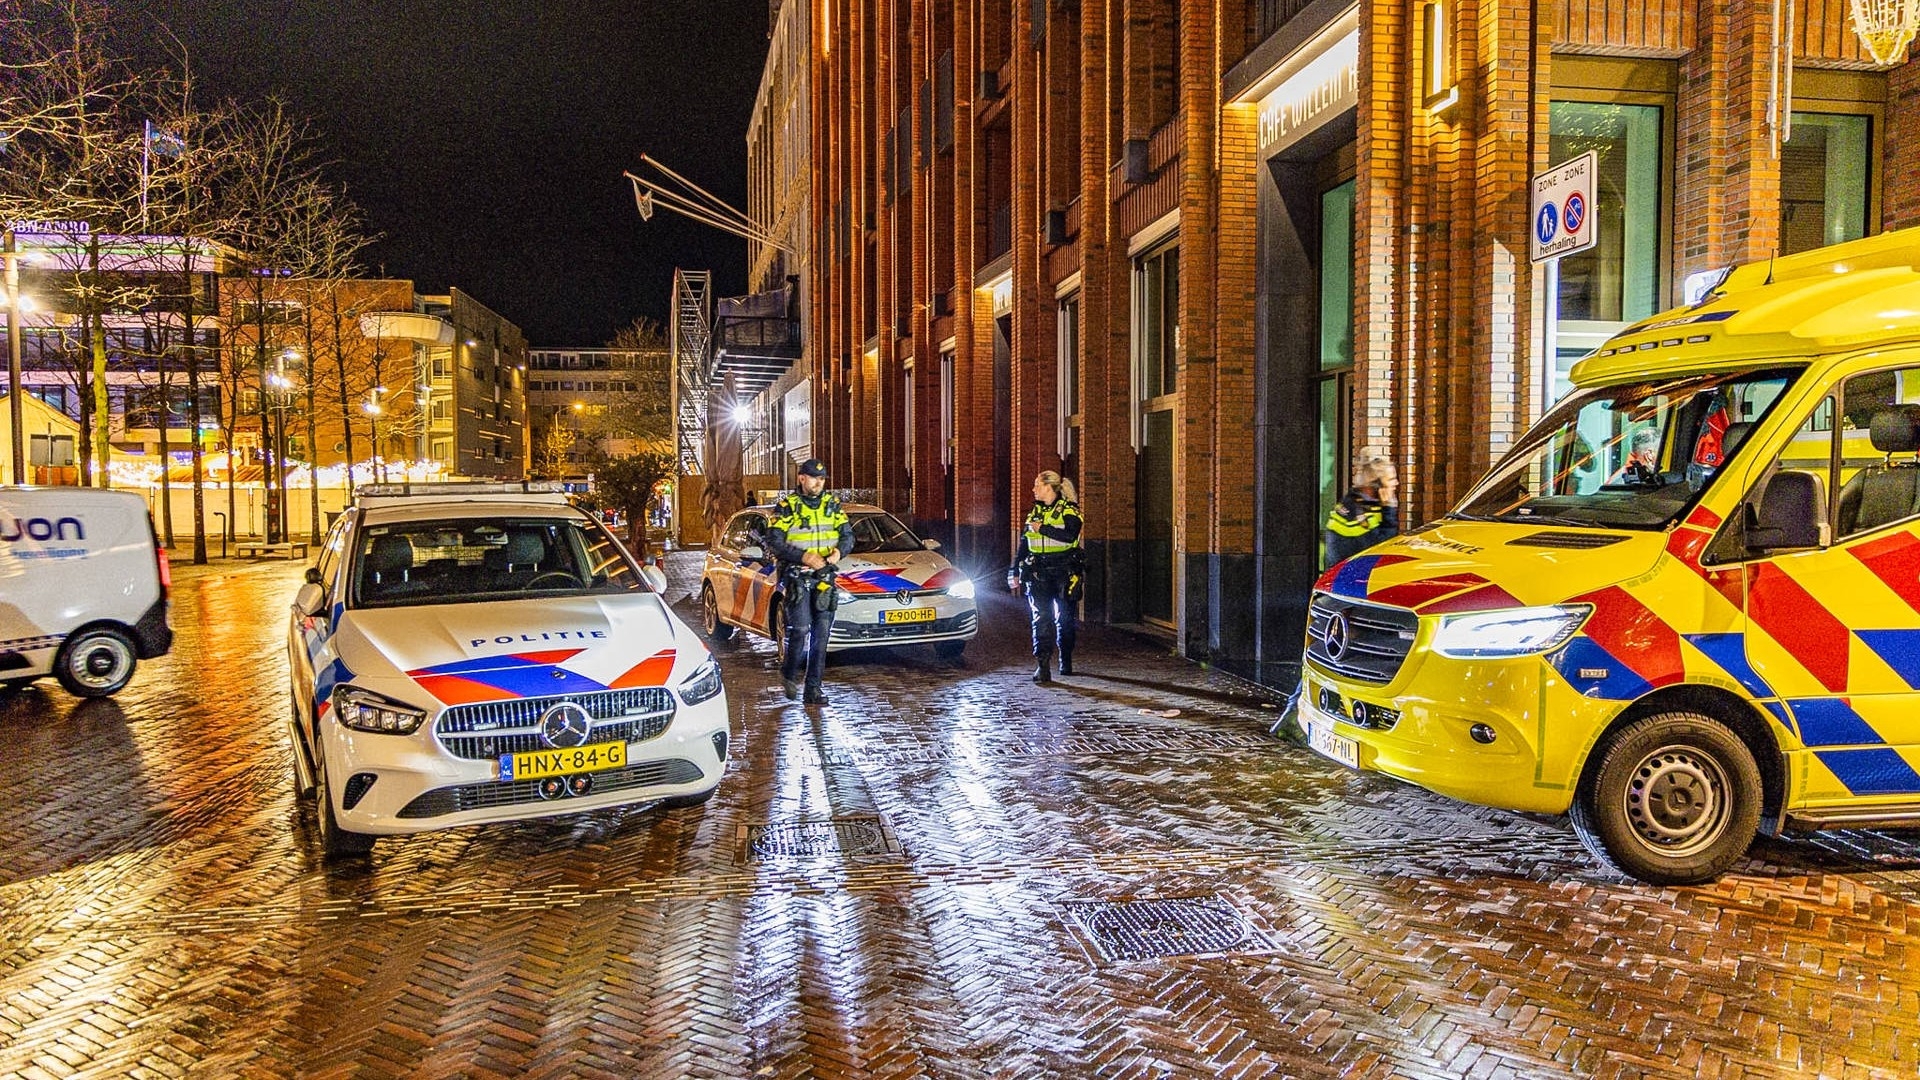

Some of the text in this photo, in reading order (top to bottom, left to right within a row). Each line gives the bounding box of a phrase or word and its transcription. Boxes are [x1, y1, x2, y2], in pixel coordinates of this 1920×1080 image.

[1538, 163, 1585, 192] ZONE ZONE
[1540, 235, 1577, 256] herhaling
[851, 560, 915, 569] POLITIE
[887, 609, 933, 623] Z-900-HF
[471, 629, 608, 648] POLITIE
[518, 745, 620, 776] HNX-84-G
